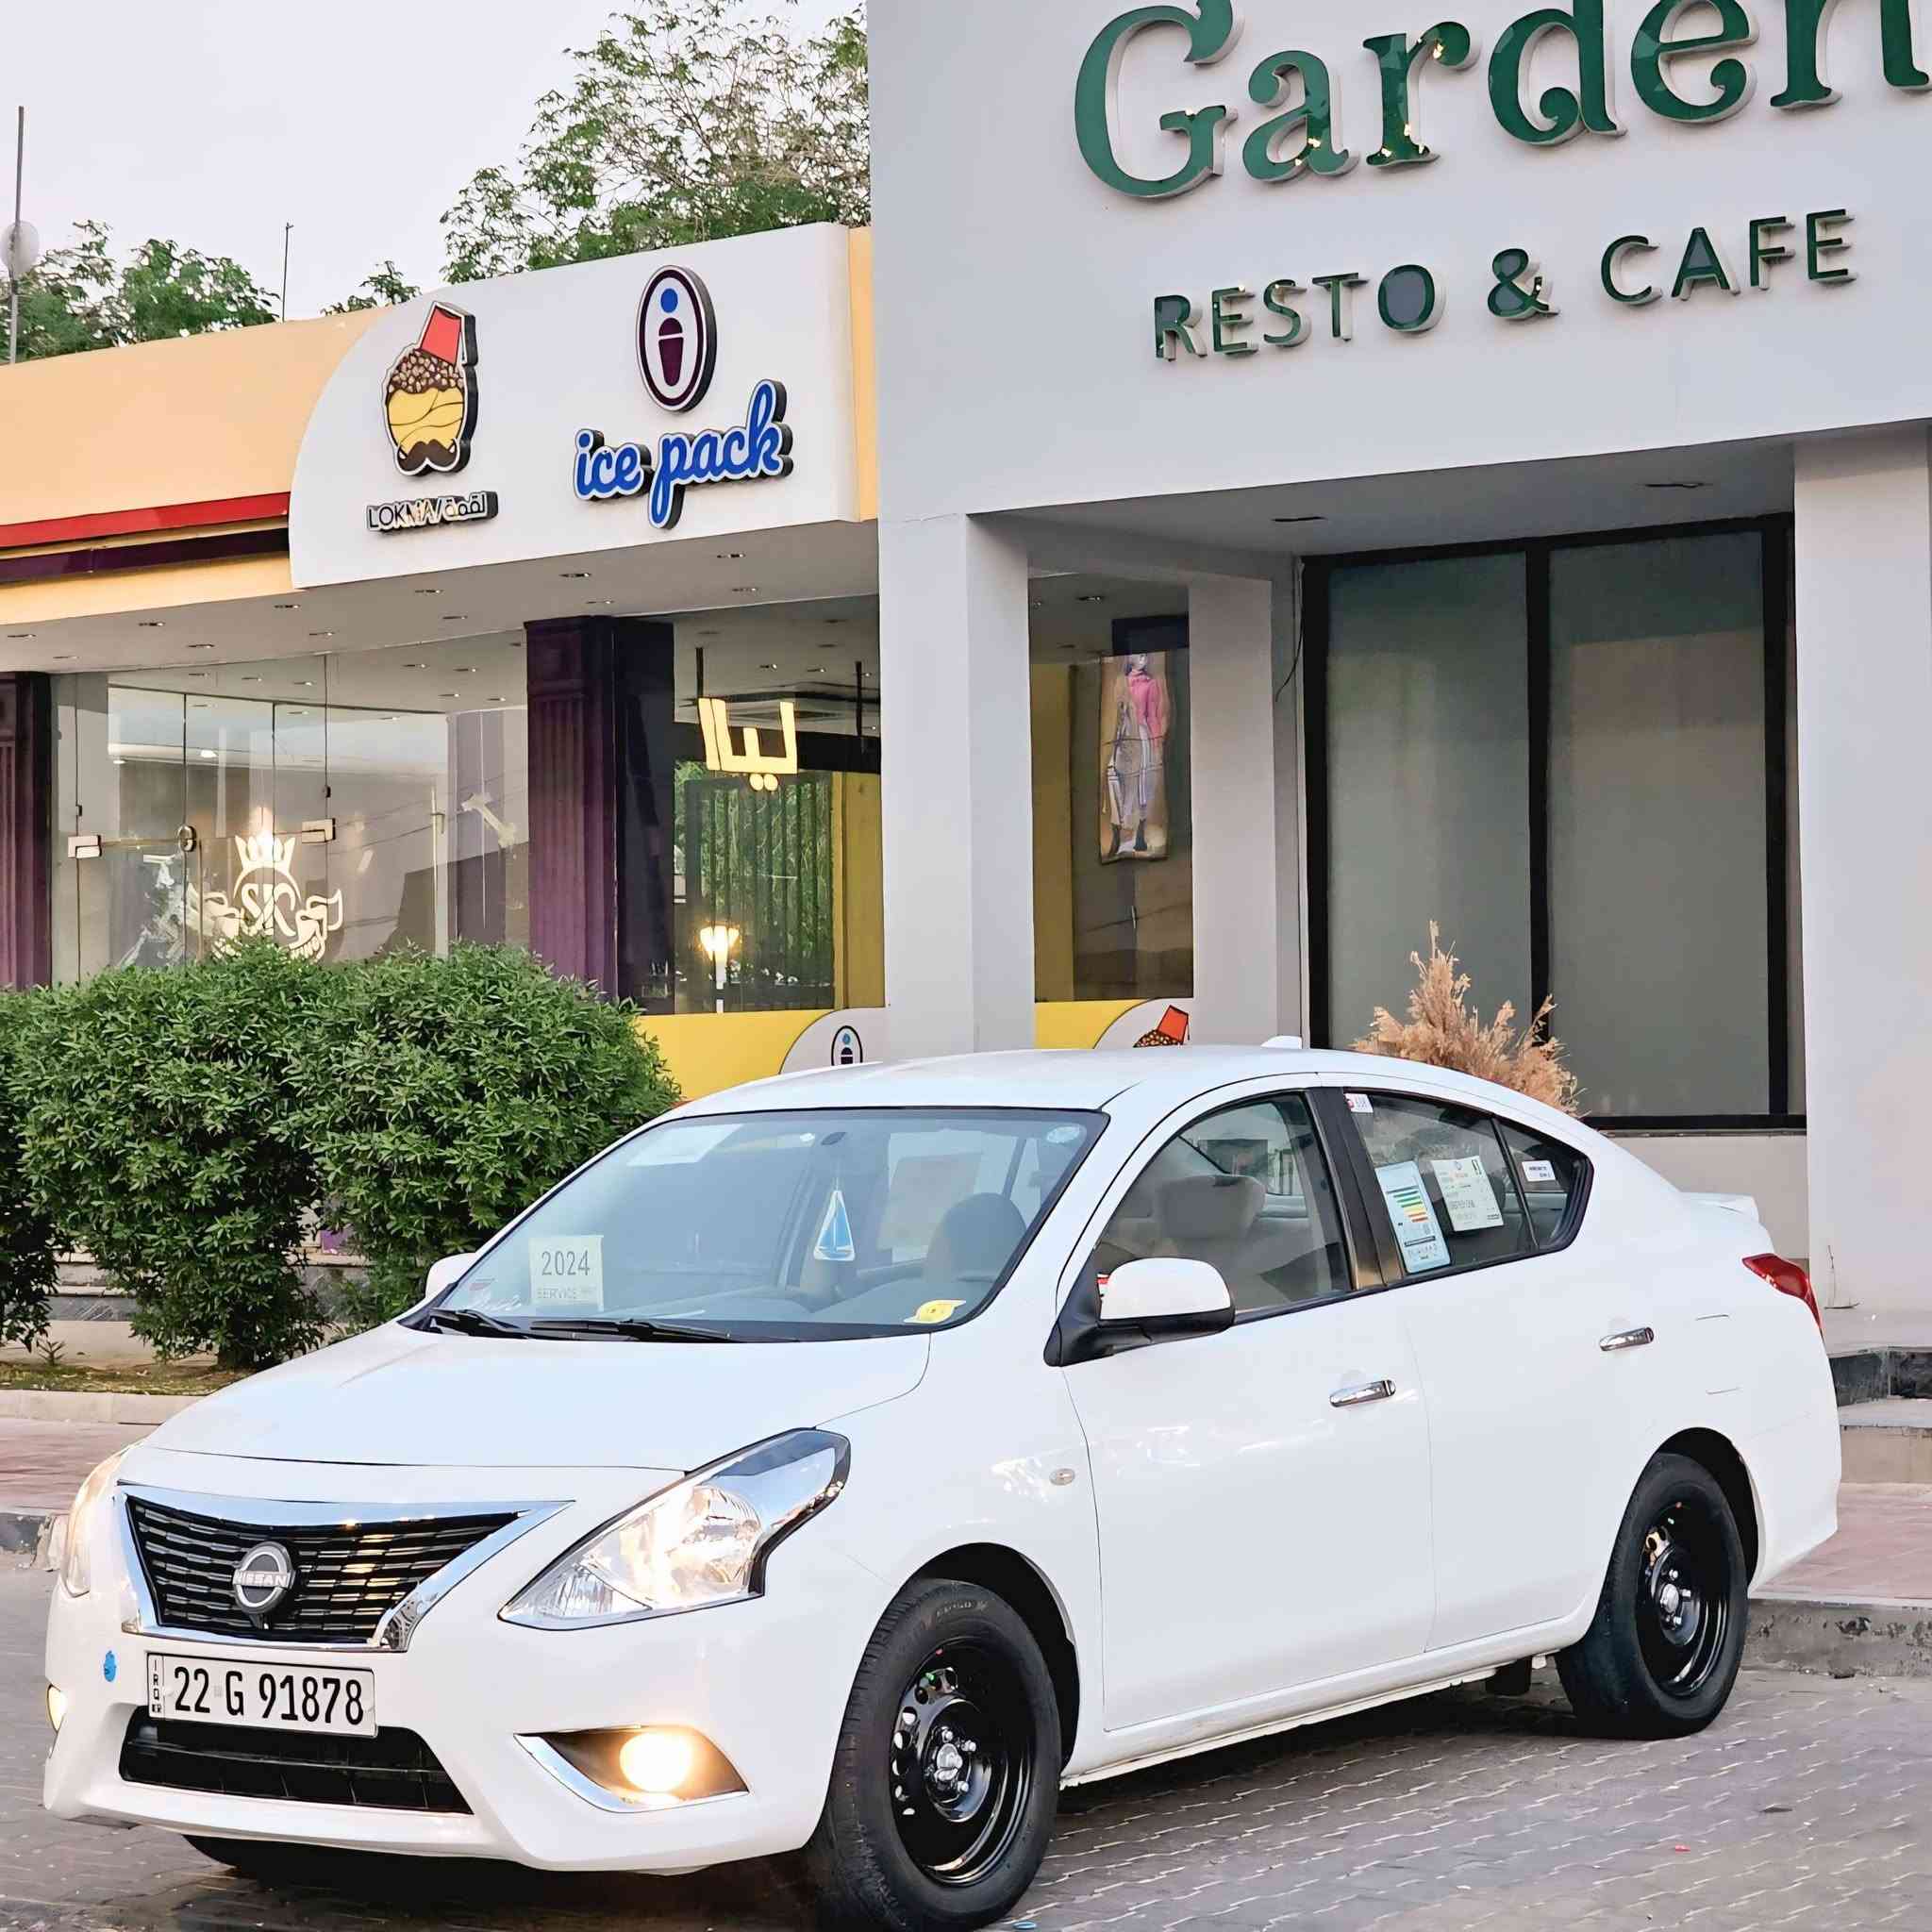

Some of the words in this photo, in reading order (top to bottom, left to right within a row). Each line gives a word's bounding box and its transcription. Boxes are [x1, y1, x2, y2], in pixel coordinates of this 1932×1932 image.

[1074, 0, 1932, 199] Garden
[1154, 264, 1445, 361] RESTO
[1487, 248, 1560, 324] &
[1600, 208, 1856, 308] CAFE
[575, 430, 646, 500] ice
[649, 380, 785, 528] pack
[541, 1250, 591, 1276] 2024
[234, 1571, 288, 1588] NISSAN
[174, 1666, 210, 1715] 22
[225, 1670, 245, 1716] G
[259, 1673, 364, 1725] 91878
